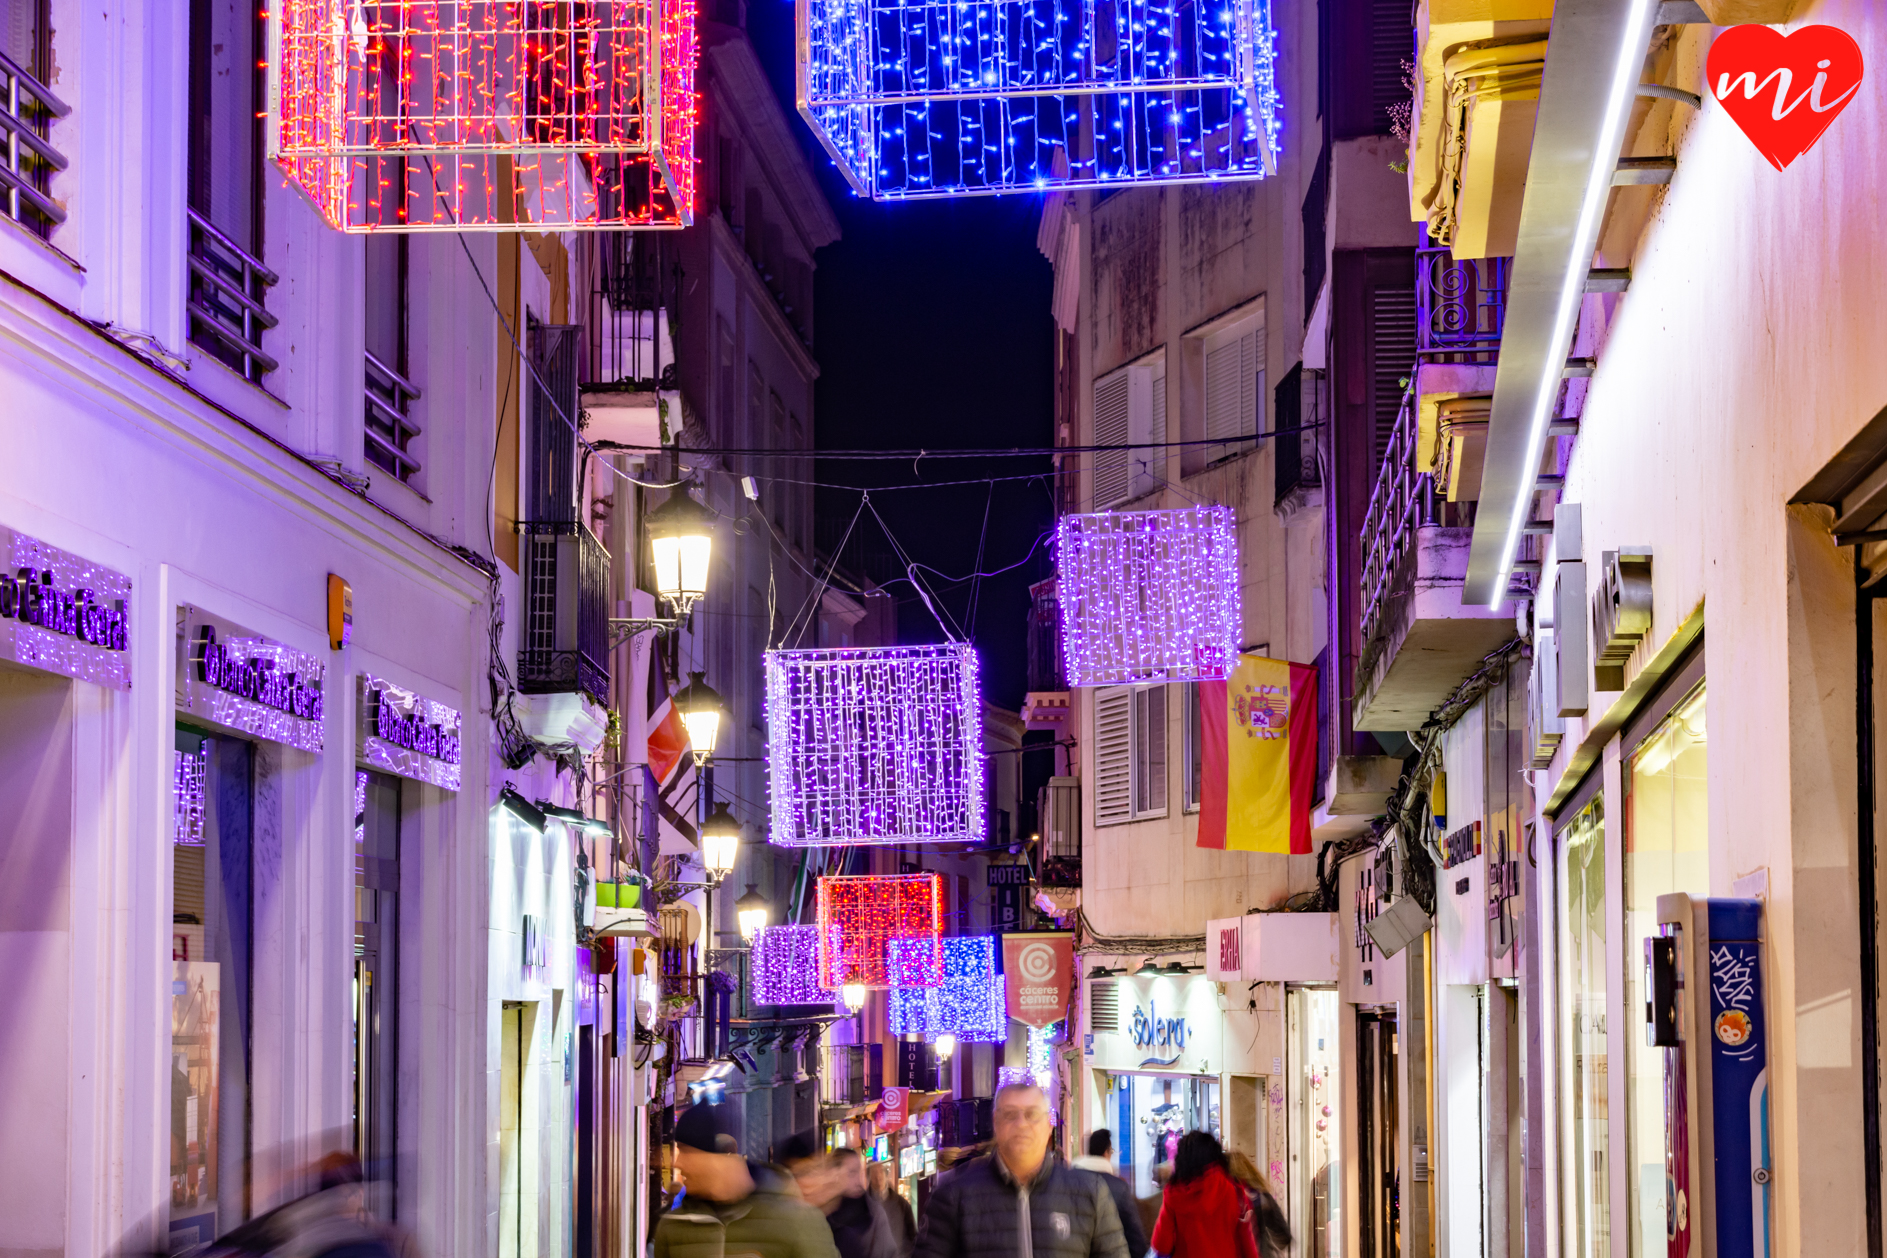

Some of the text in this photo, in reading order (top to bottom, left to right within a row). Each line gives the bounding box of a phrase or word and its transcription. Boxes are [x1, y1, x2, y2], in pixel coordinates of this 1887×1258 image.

[17, 568, 76, 635] Caixa
[75, 588, 128, 652] Geral
[250, 657, 291, 711] Caixa
[989, 867, 1027, 884] HOTEL
[1019, 985, 1058, 995] cáceres
[1019, 995, 1058, 1005] centro
[1133, 998, 1185, 1048] solera
